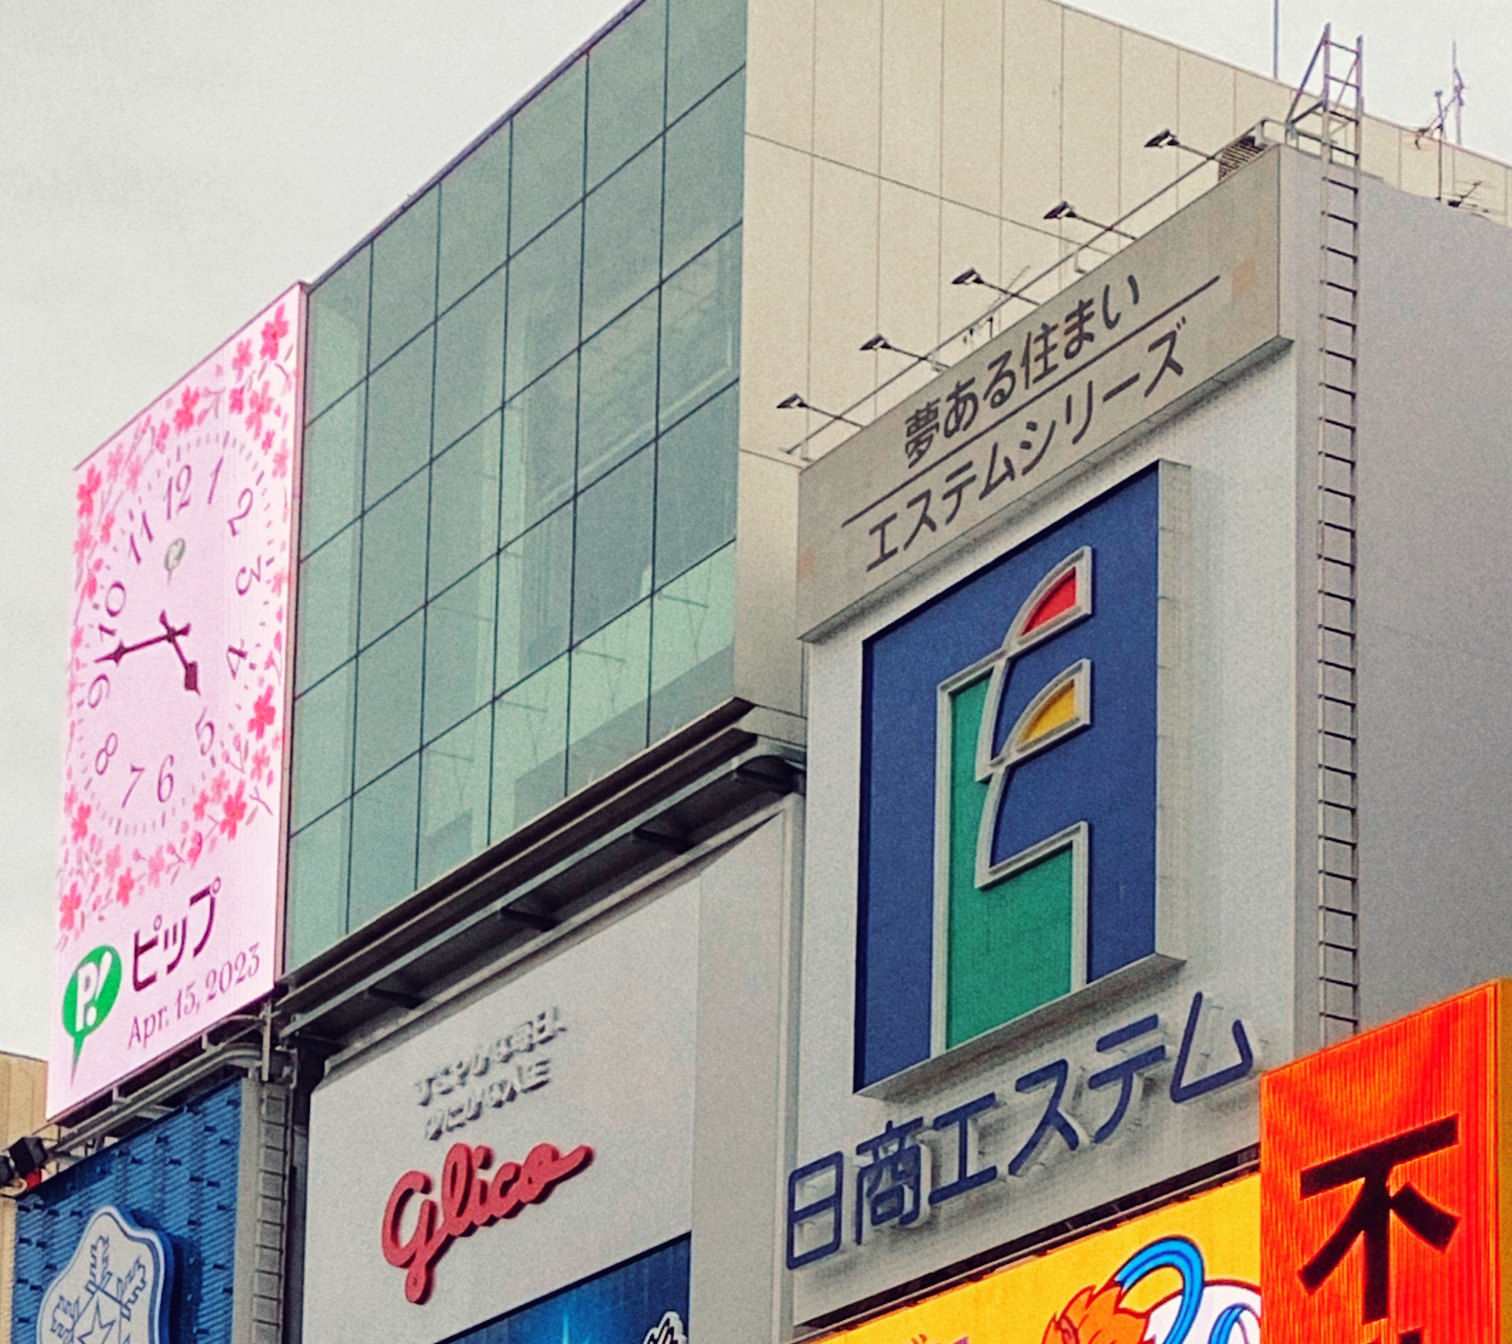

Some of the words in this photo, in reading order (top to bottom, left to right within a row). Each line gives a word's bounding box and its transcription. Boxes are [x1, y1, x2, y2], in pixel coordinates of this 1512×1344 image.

[904, 273, 1141, 467] 夢ある住まい
[864, 317, 1190, 571] エステムシリーズ
[164, 463, 192, 521] 12
[207, 455, 224, 506] 1
[129, 509, 154, 565] 11
[227, 487, 254, 537] 2
[235, 554, 262, 596] 3
[97, 580, 127, 641] 10
[225, 638, 249, 680] 4
[94, 731, 119, 776] 8
[194, 706, 215, 756] 5
[121, 763, 145, 809] 7
[156, 754, 175, 803] 6
[131, 876, 222, 992] ピップ
[127, 1005, 169, 1051] Apr.
[175, 980, 202, 1021] 15,
[204, 941, 261, 1002] 2023
[786, 989, 1256, 1272] 日商エステム
